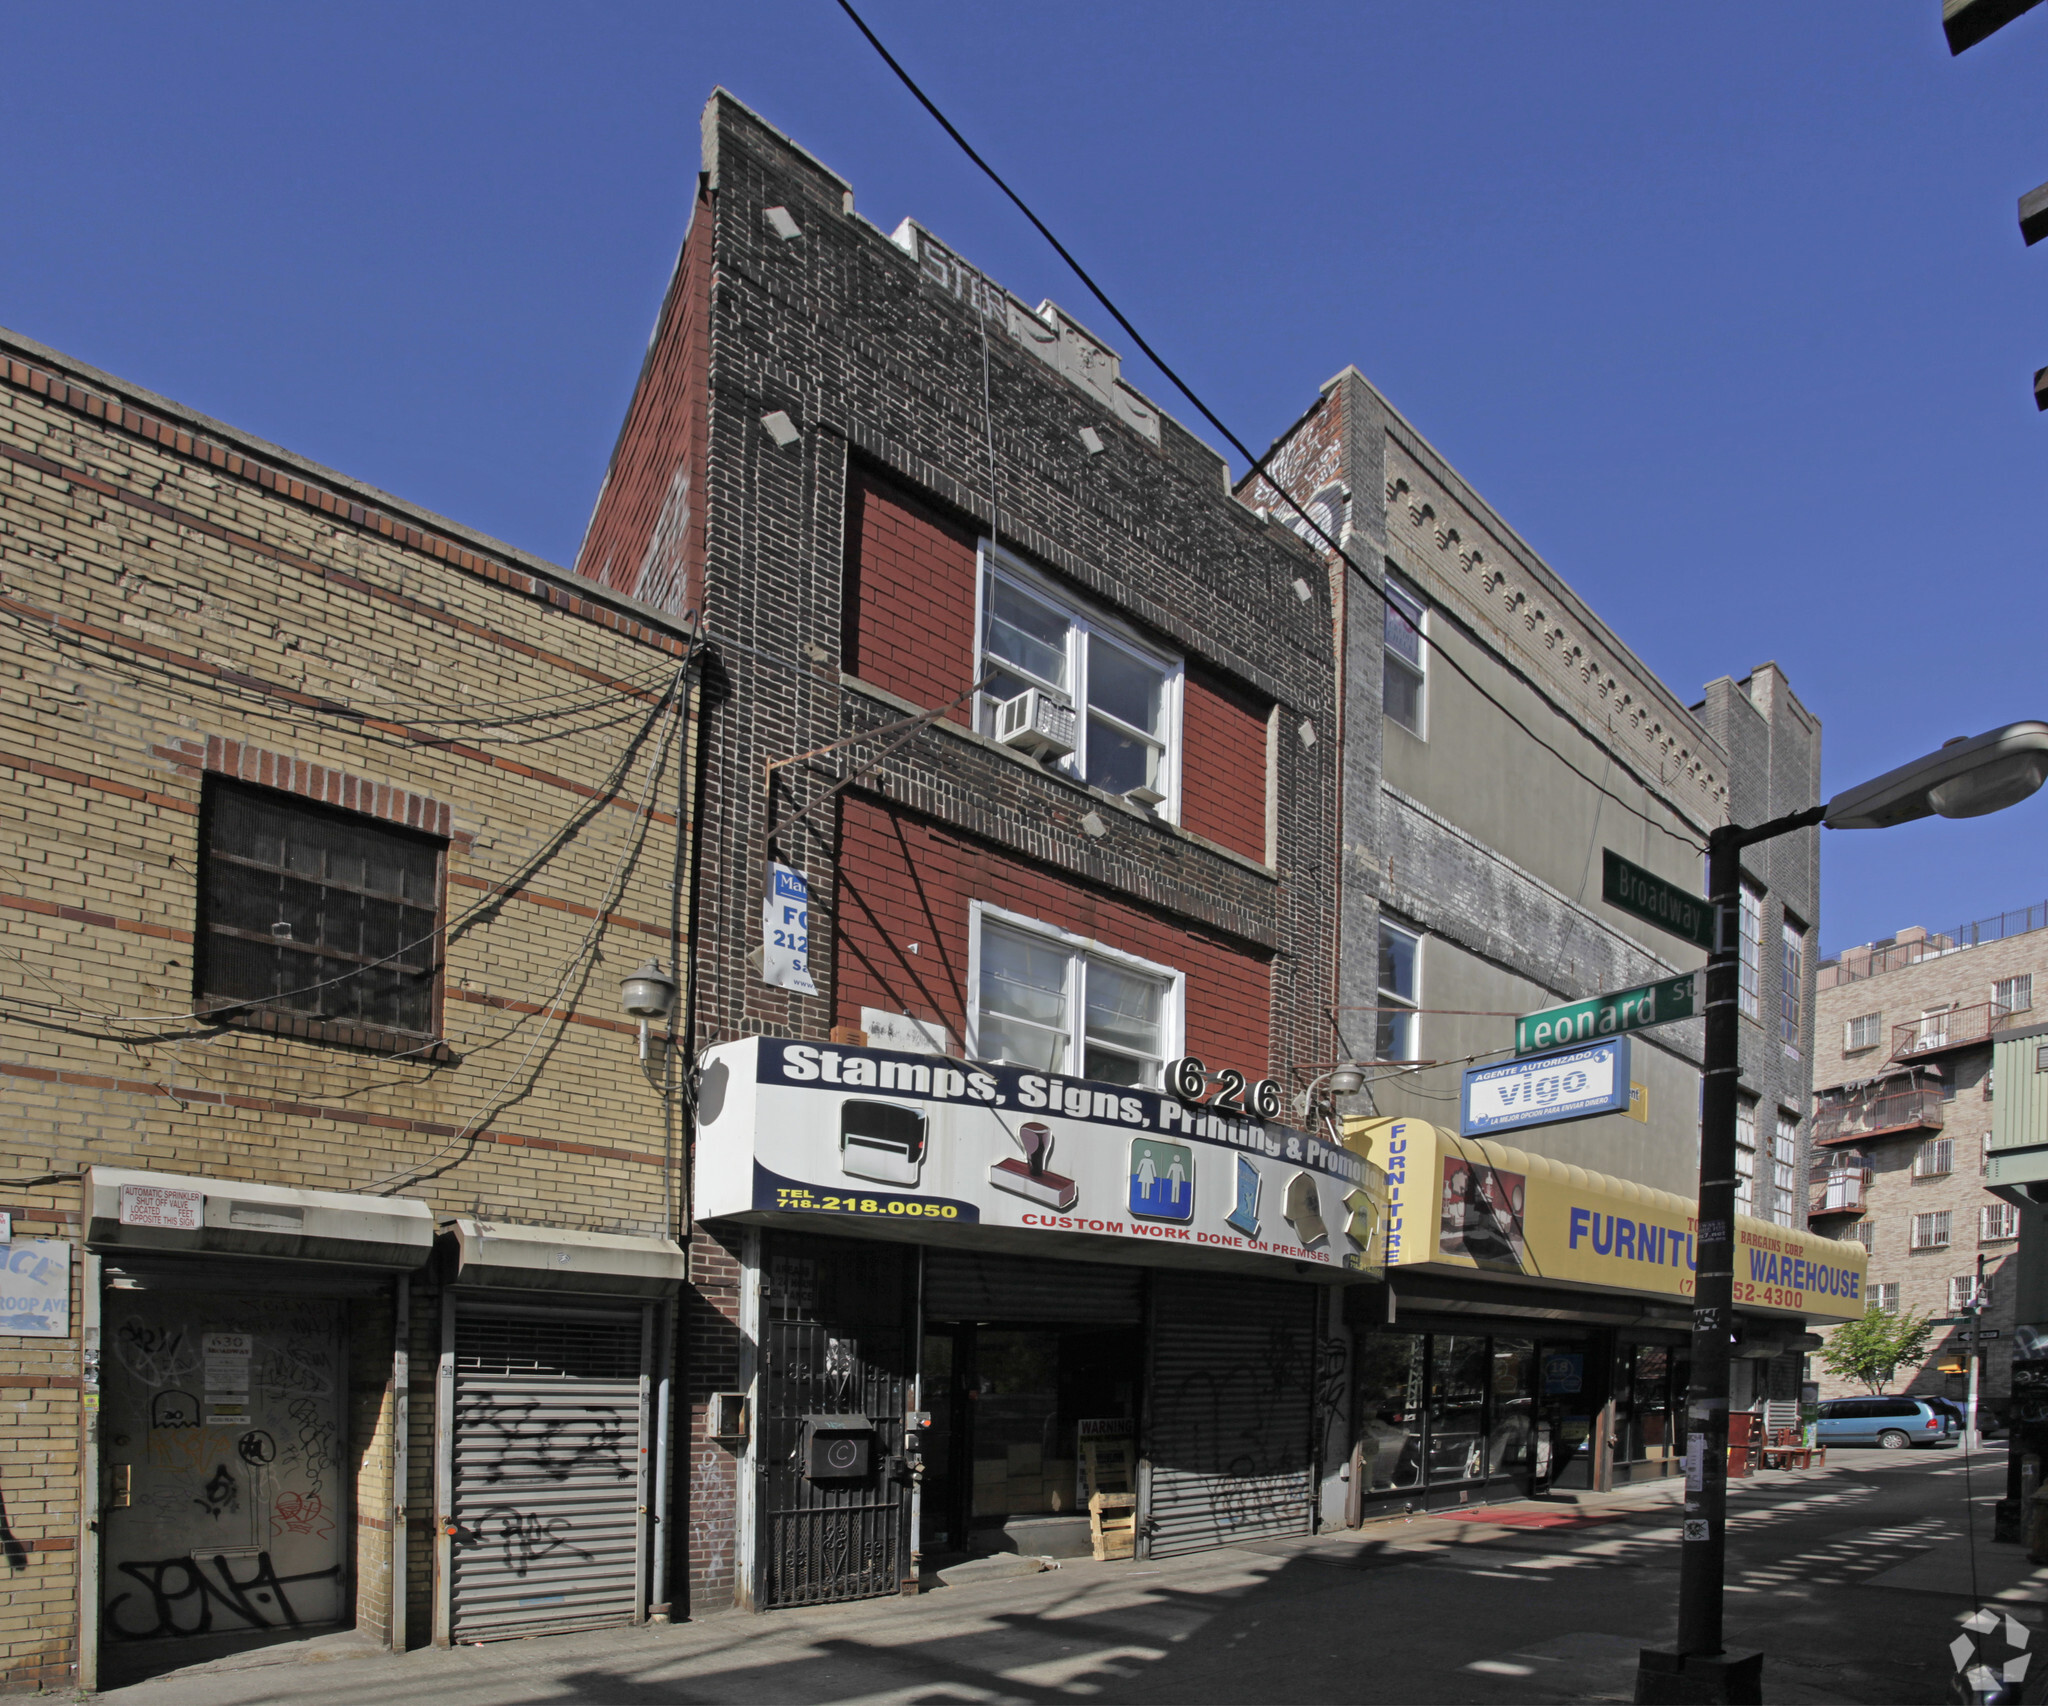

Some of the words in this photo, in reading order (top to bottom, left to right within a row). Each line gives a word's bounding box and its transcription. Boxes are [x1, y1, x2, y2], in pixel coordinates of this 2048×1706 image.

[1619, 863, 1701, 940] Broadway
[1519, 986, 1656, 1052] Leonard
[1672, 979, 1695, 1001] St
[1475, 1068, 1518, 1082] AGENTE
[1520, 1051, 1592, 1073] AUTORIZADO
[1173, 1056, 1282, 1119] 626
[783, 1044, 1006, 1105] Stamps,
[1018, 1074, 1150, 1128] Signs,
[1159, 1100, 1281, 1157] Printing
[1286, 1136, 1302, 1161] &
[1490, 1117, 1499, 1125] LA
[1500, 1114, 1520, 1123] MEJOR
[1521, 1110, 1543, 1120] OPCION
[1544, 1107, 1561, 1116] PARA
[1562, 1102, 1584, 1112] ENVIAR
[1585, 1097, 1608, 1108] DINERO
[125, 1187, 163, 1198] AUTOMATIC
[164, 1190, 200, 1202] SPRINKLER
[136, 1197, 154, 1206] SHUT
[155, 1198, 168, 1207] OFF
[169, 1200, 189, 1209] VALVE
[776, 1189, 815, 1198] TEL
[776, 1196, 958, 1218] 718.218.0050
[1383, 1124, 1407, 1264] FURNITURE
[129, 1214, 162, 1224] OPPOSITE
[163, 1216, 178, 1226] THIS
[179, 1217, 195, 1226] SIGN
[130, 1205, 160, 1215] LOCATED
[178, 1209, 194, 1218] FEET
[1021, 1213, 1123, 1233] CUSTOM
[1131, 1223, 1191, 1240] WORK
[1197, 1232, 1242, 1248] DONE
[1247, 1239, 1269, 1252] ON
[1272, 1243, 1331, 1263] PREMISES
[1741, 1231, 1781, 1252] BARGAINS
[1569, 1206, 1697, 1271] FURNITU
[1750, 1248, 1859, 1299] WAREHOUSE
[1733, 1281, 1804, 1308] 52-4300
[1081, 1419, 1132, 1434] WARNING
